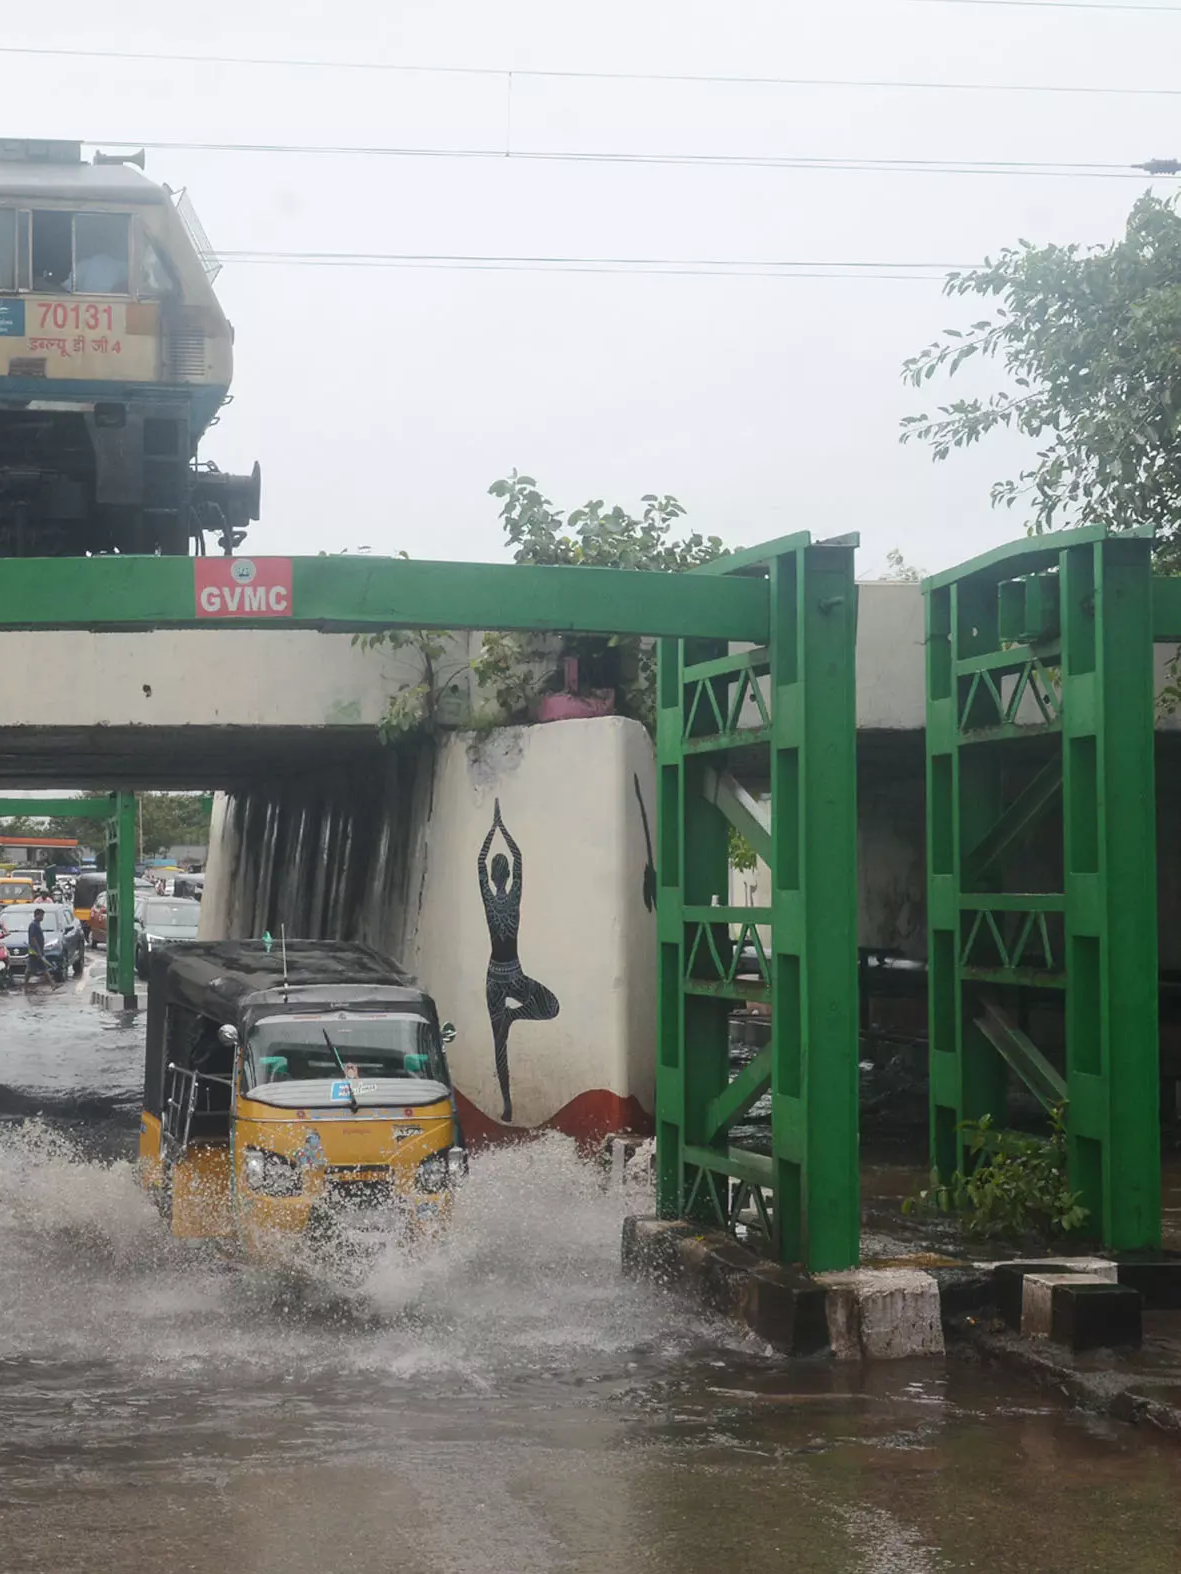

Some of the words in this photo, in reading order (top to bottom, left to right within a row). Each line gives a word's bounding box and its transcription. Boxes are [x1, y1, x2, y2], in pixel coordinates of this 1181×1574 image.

[37, 303, 112, 331] 70131
[111, 340, 121, 354] 4
[200, 585, 288, 612] GVMC
